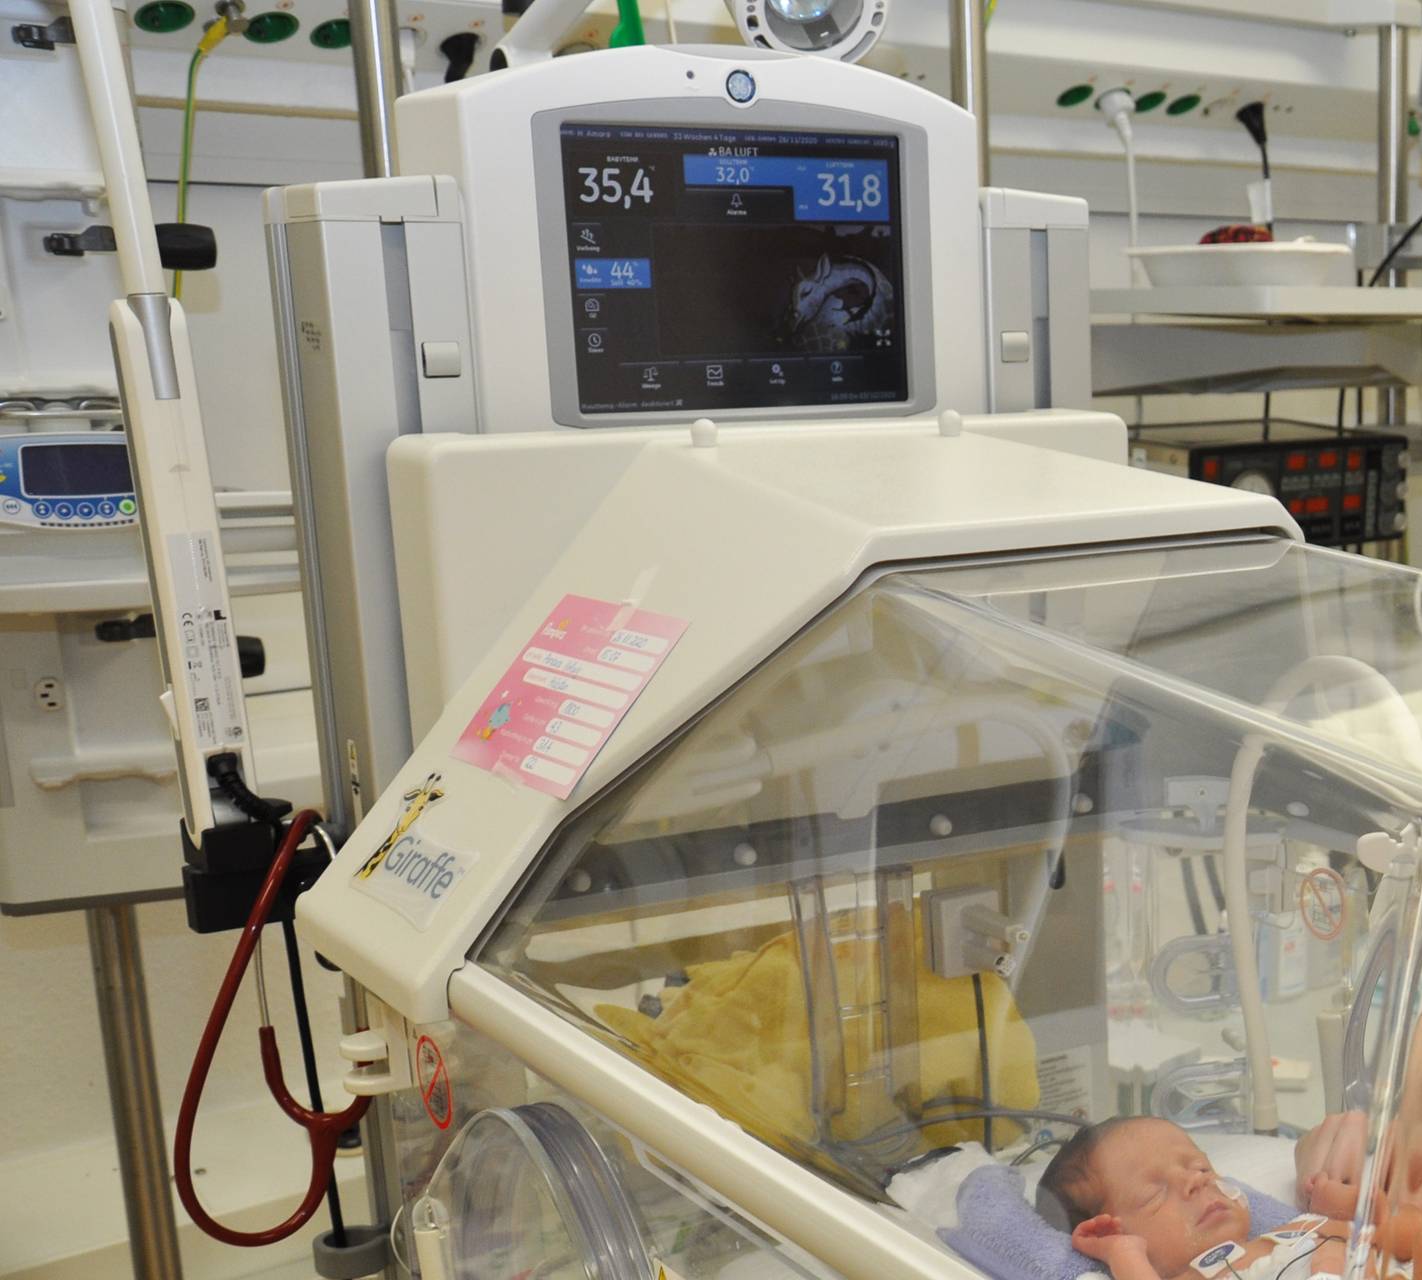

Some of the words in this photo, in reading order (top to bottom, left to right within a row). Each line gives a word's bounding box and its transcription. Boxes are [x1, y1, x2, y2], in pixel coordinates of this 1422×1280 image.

[683, 133, 713, 141] Wochen
[734, 147, 759, 158] LUFT
[715, 167, 750, 185] 32,0
[578, 167, 654, 210] 35,4
[816, 172, 882, 213] 31,8
[610, 261, 634, 279] 44
[383, 836, 454, 900] Giraffe
